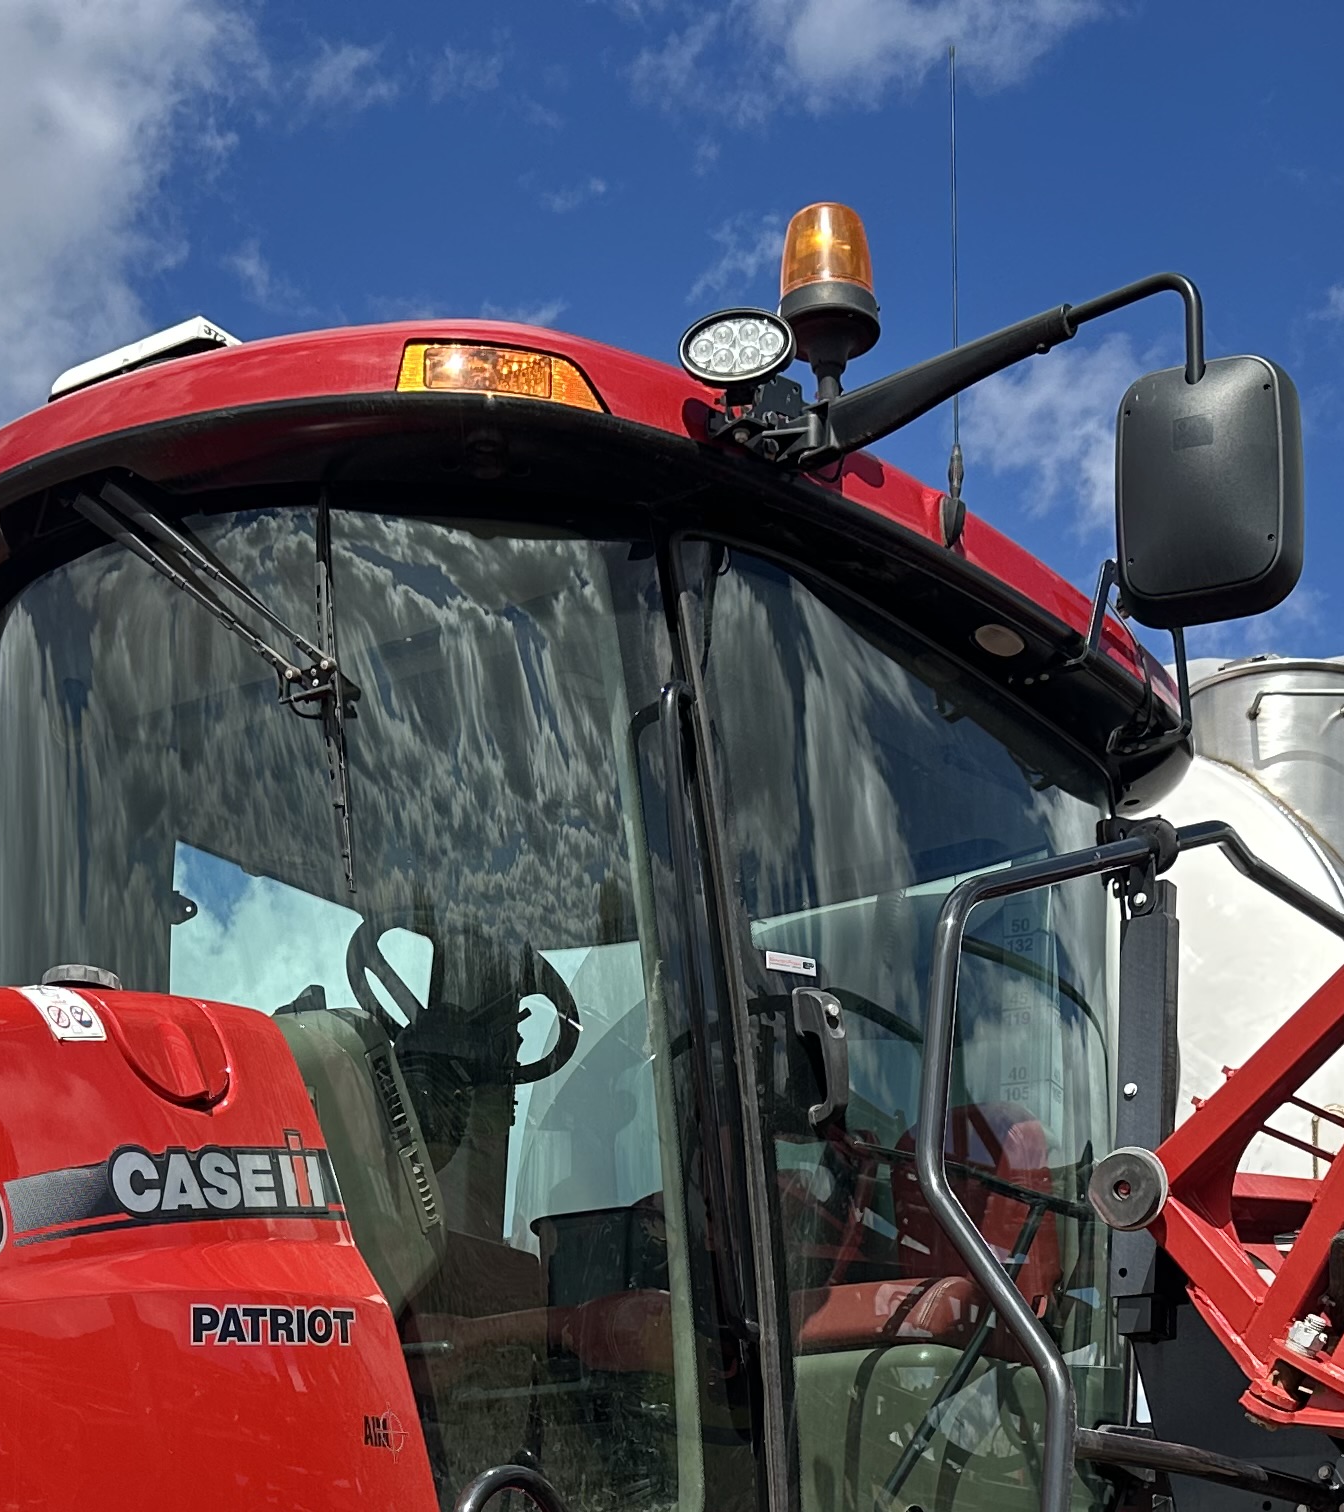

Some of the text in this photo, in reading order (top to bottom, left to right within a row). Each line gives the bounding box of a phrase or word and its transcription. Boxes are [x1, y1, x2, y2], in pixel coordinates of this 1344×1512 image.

[1010, 917, 1031, 933] 50
[1007, 937, 1034, 953] 132
[1007, 1066, 1028, 1081] 40
[1005, 1086, 1030, 1101] 105
[189, 1303, 355, 1346] PATRIOT
